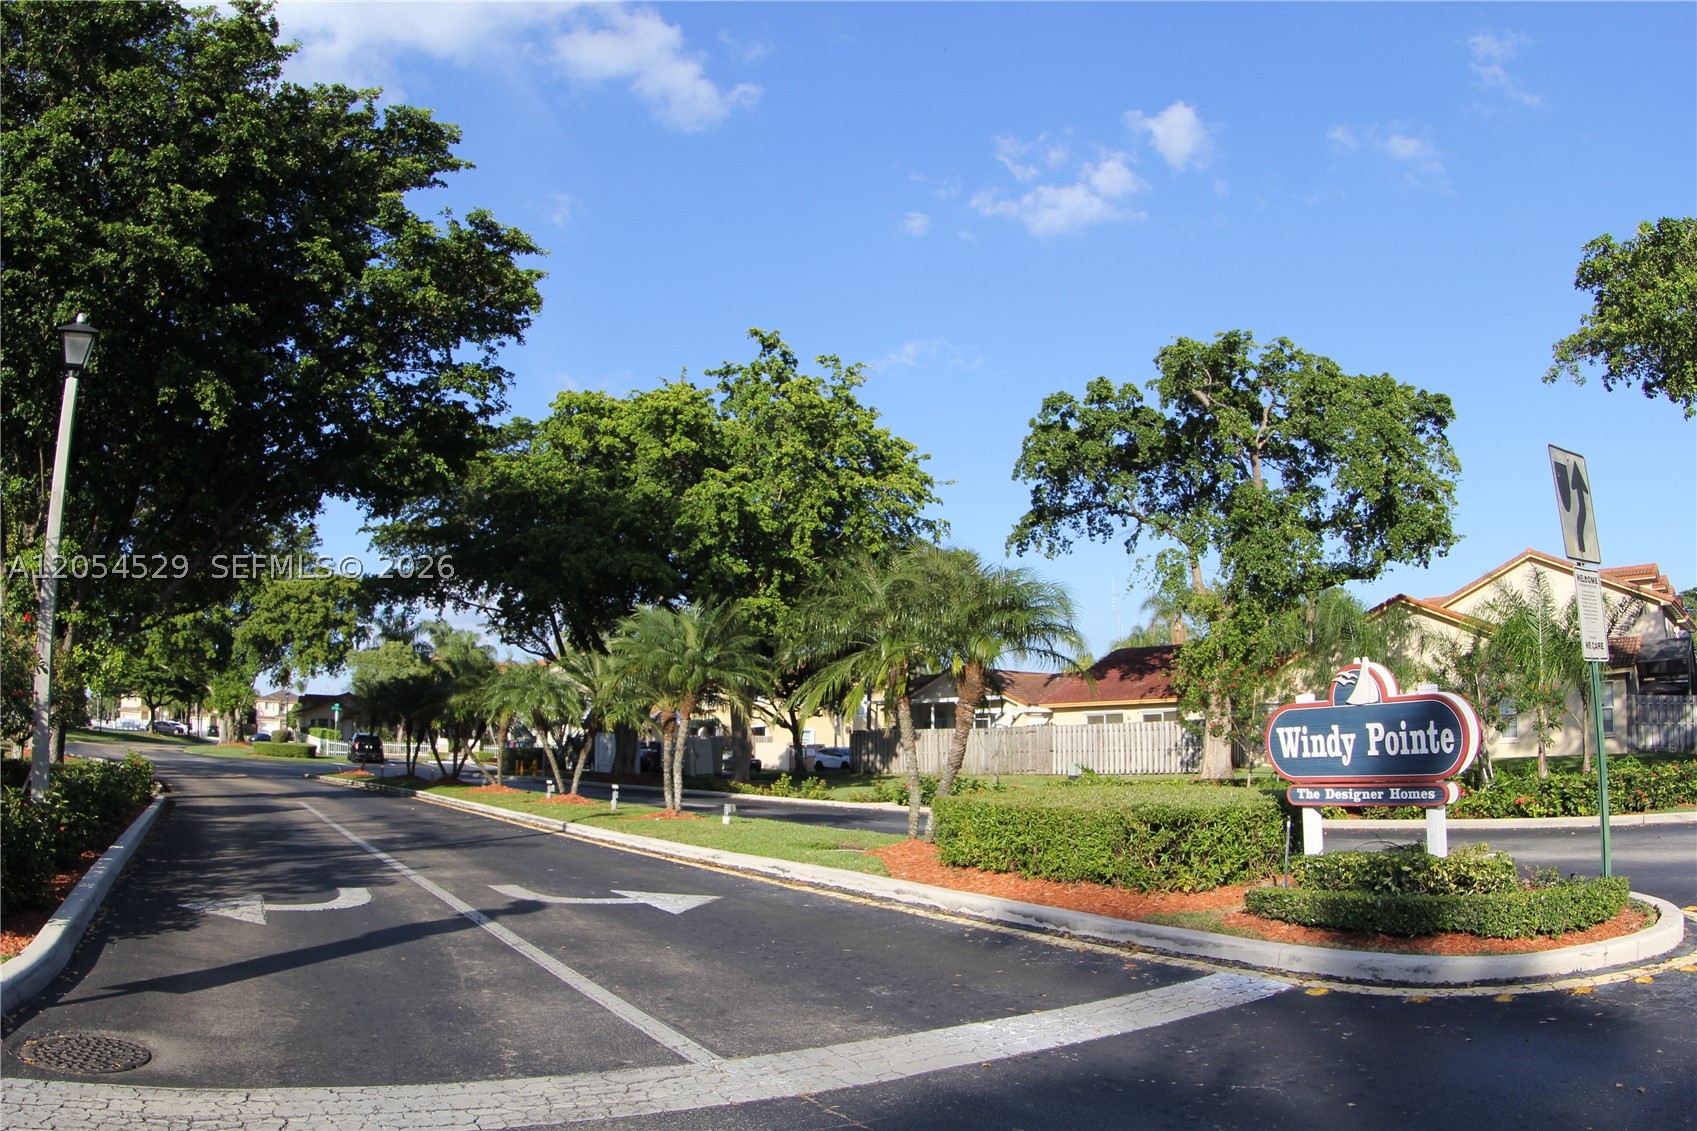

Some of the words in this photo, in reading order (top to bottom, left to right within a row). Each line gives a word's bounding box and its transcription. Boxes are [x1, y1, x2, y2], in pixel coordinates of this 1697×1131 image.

[1276, 724, 1356, 767] Windy
[1365, 720, 1455, 757] Pointe
[1296, 788, 1320, 800] The
[1324, 788, 1384, 802] Designer
[1389, 788, 1436, 800] Homes
